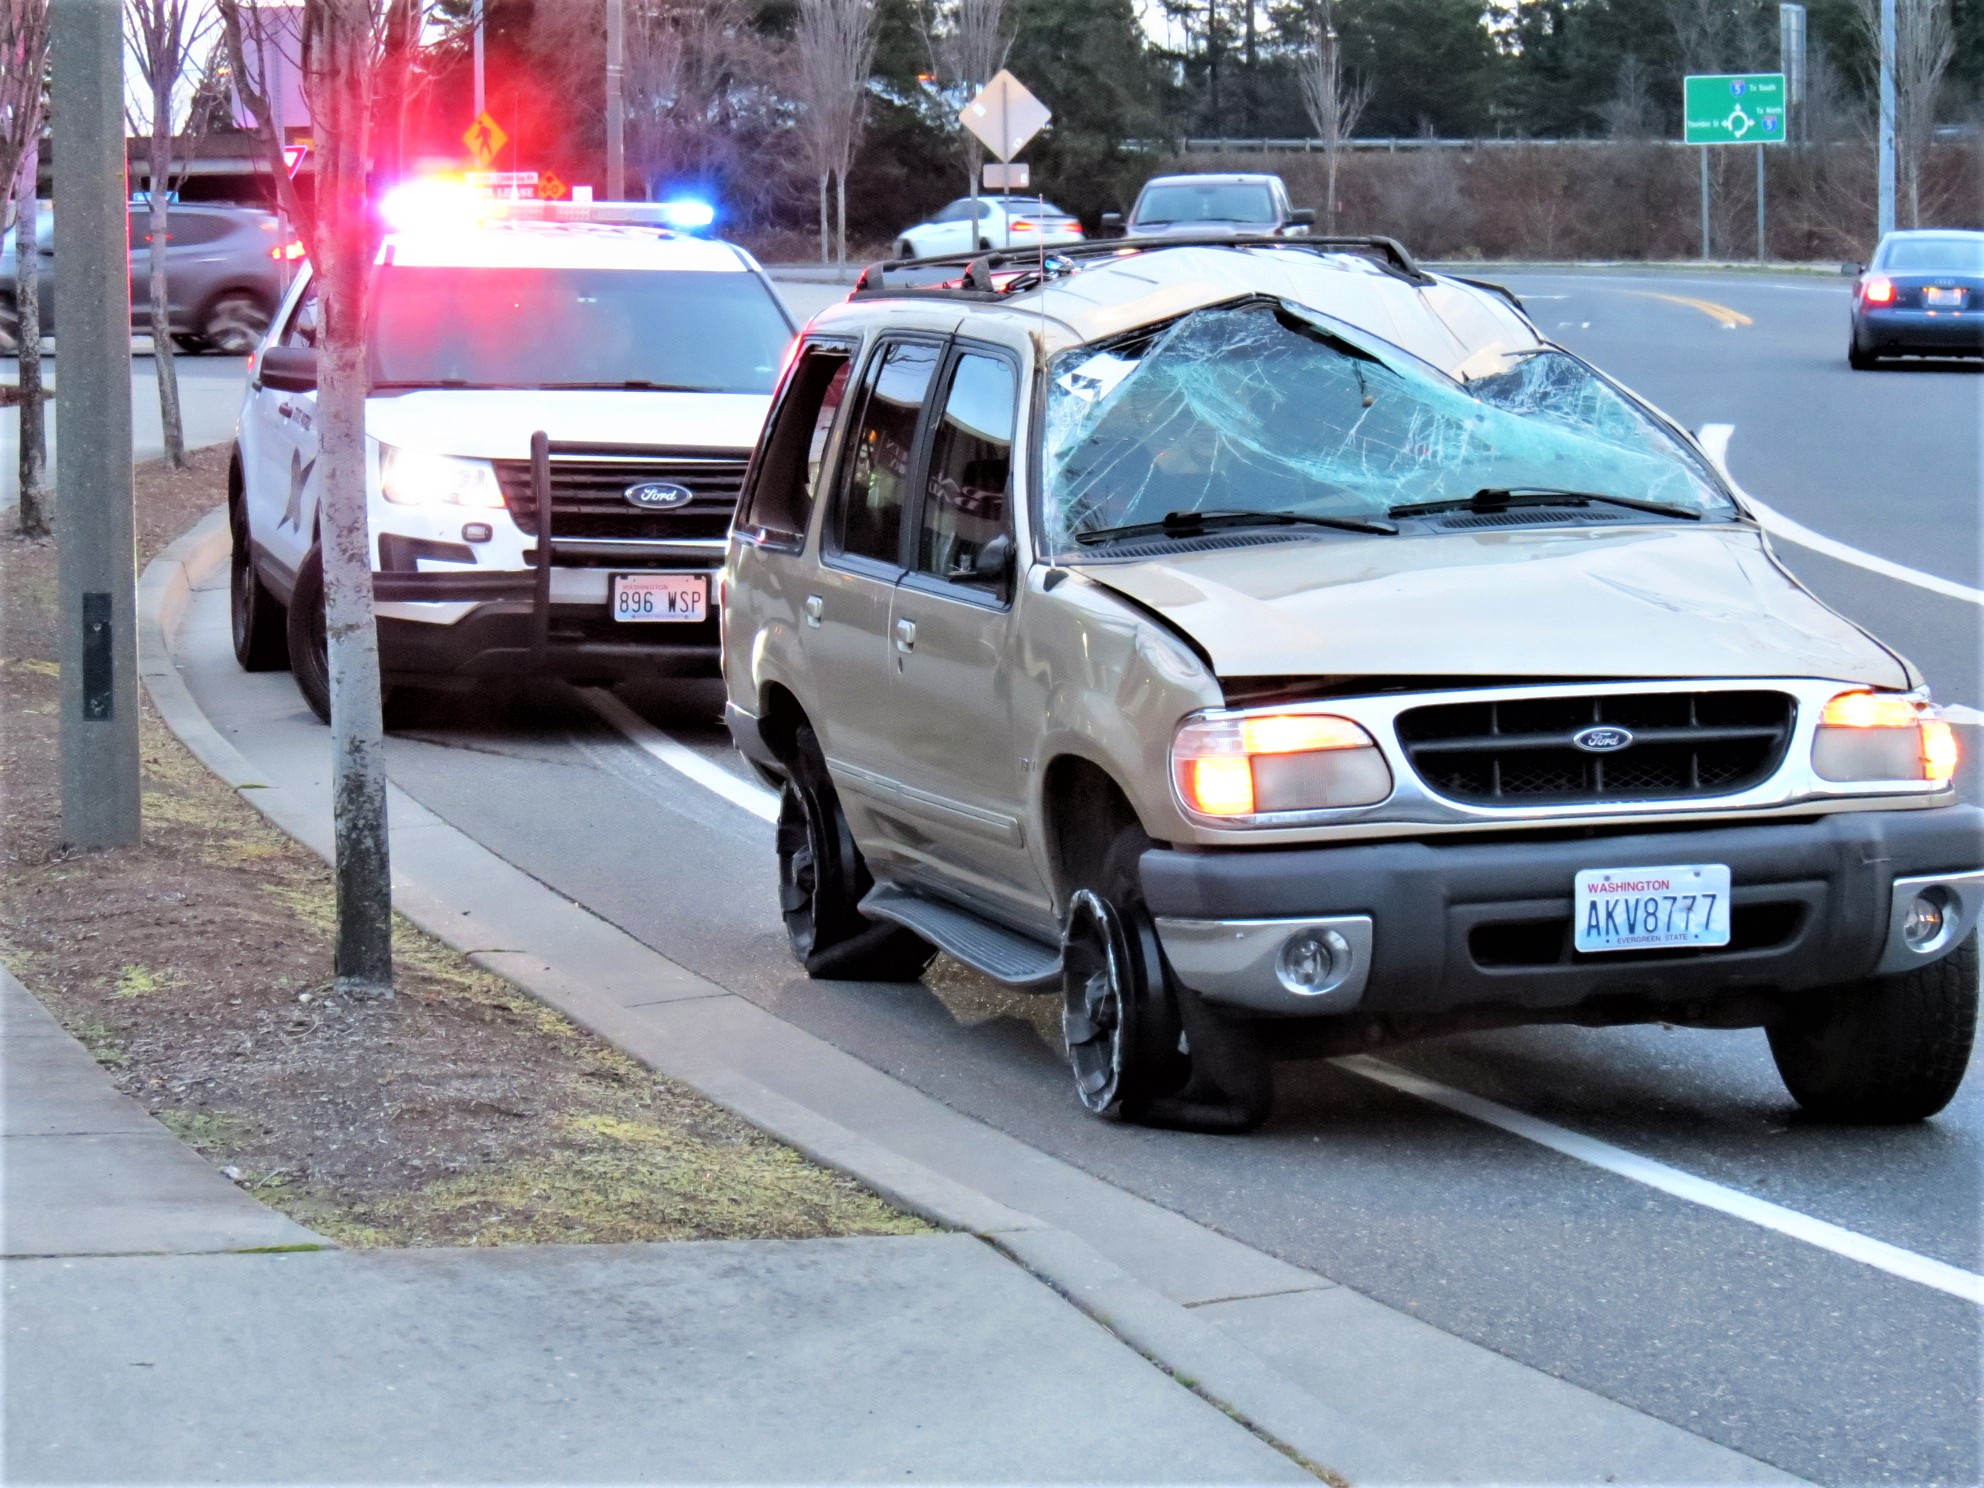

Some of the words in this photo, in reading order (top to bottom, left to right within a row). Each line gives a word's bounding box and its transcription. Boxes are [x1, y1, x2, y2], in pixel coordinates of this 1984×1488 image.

[1734, 84, 1741, 95] 5
[1749, 83, 1757, 92] To
[1758, 83, 1777, 91] South
[497, 187, 534, 198] LESE
[641, 488, 677, 501] Ford
[619, 591, 654, 614] 896
[667, 591, 702, 614] WSP
[1588, 732, 1619, 747] Ford
[1588, 880, 1670, 894] WASHINGTON
[1586, 894, 1717, 938] AKV8777
[1617, 936, 1661, 945] EVERGREEN
[1664, 933, 1688, 942] STATE
